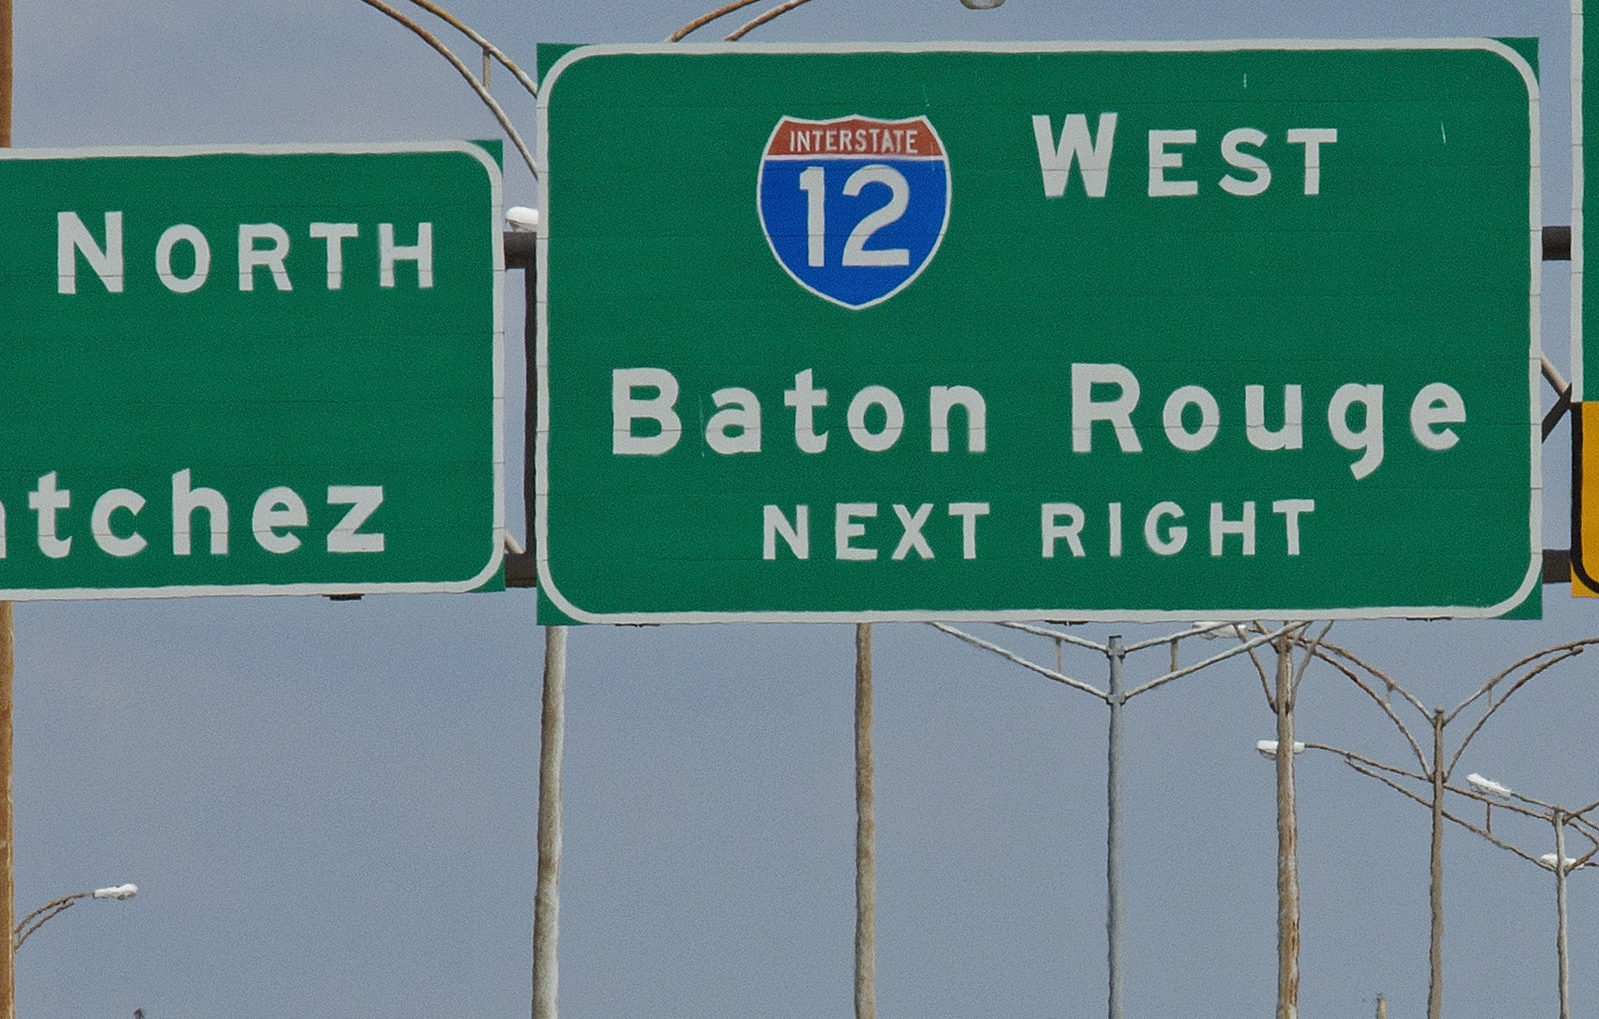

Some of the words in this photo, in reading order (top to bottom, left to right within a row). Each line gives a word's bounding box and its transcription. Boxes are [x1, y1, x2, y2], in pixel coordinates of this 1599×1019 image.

[790, 129, 919, 154] INTERSTATE
[1032, 113, 1338, 197] WEST
[57, 211, 434, 294] NORTH
[799, 164, 911, 268] 12
[612, 368, 987, 455] Baton
[1071, 363, 1467, 481] Rouge
[0, 468, 385, 558] tchez
[763, 502, 990, 561] NEXT
[1042, 499, 1316, 559] RIGHT
